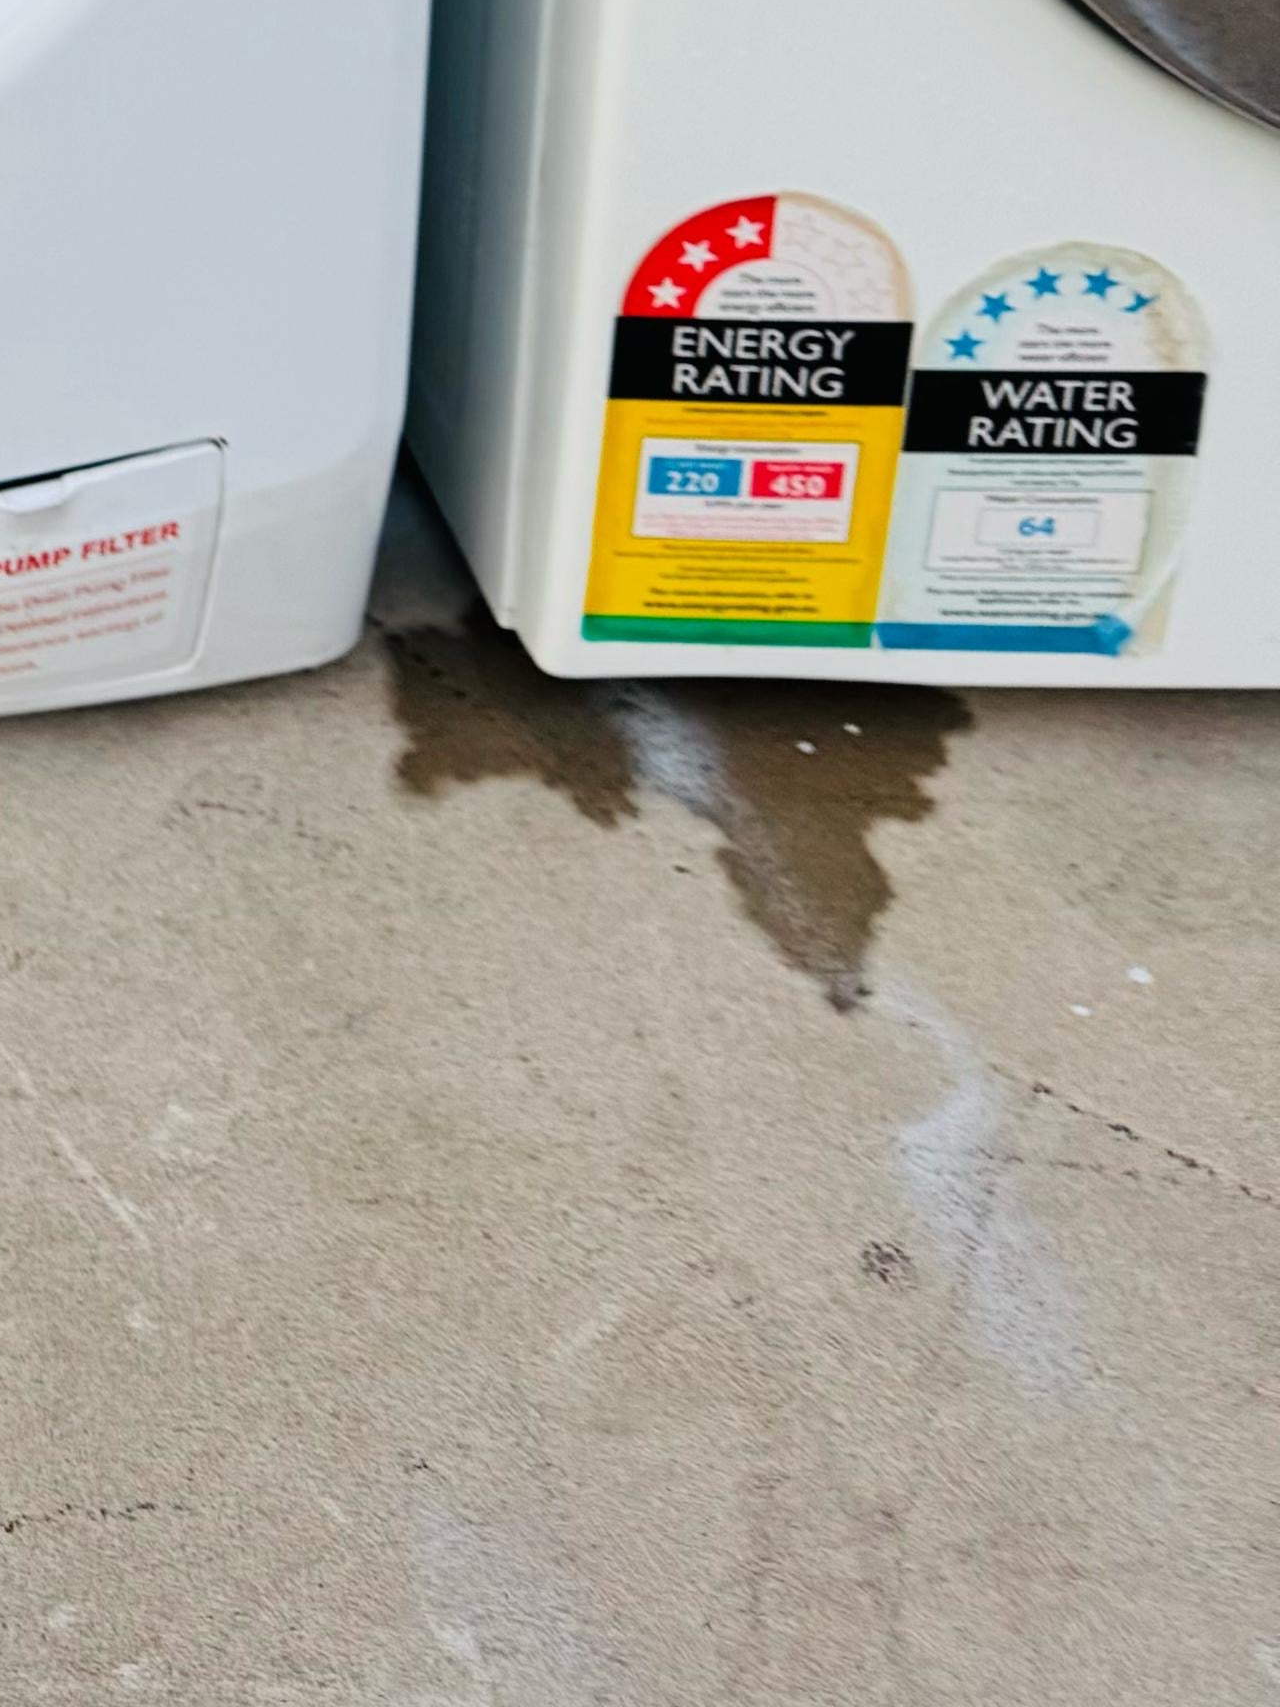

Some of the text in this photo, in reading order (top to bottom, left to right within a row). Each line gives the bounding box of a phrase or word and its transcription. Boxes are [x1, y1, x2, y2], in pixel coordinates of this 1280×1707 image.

[672, 325, 855, 362] ENERGY
[672, 363, 845, 399] RATING
[980, 379, 1137, 412] WATER
[967, 416, 1139, 449] RATING
[665, 470, 827, 497] 220 450
[80, 521, 181, 560] FILTER
